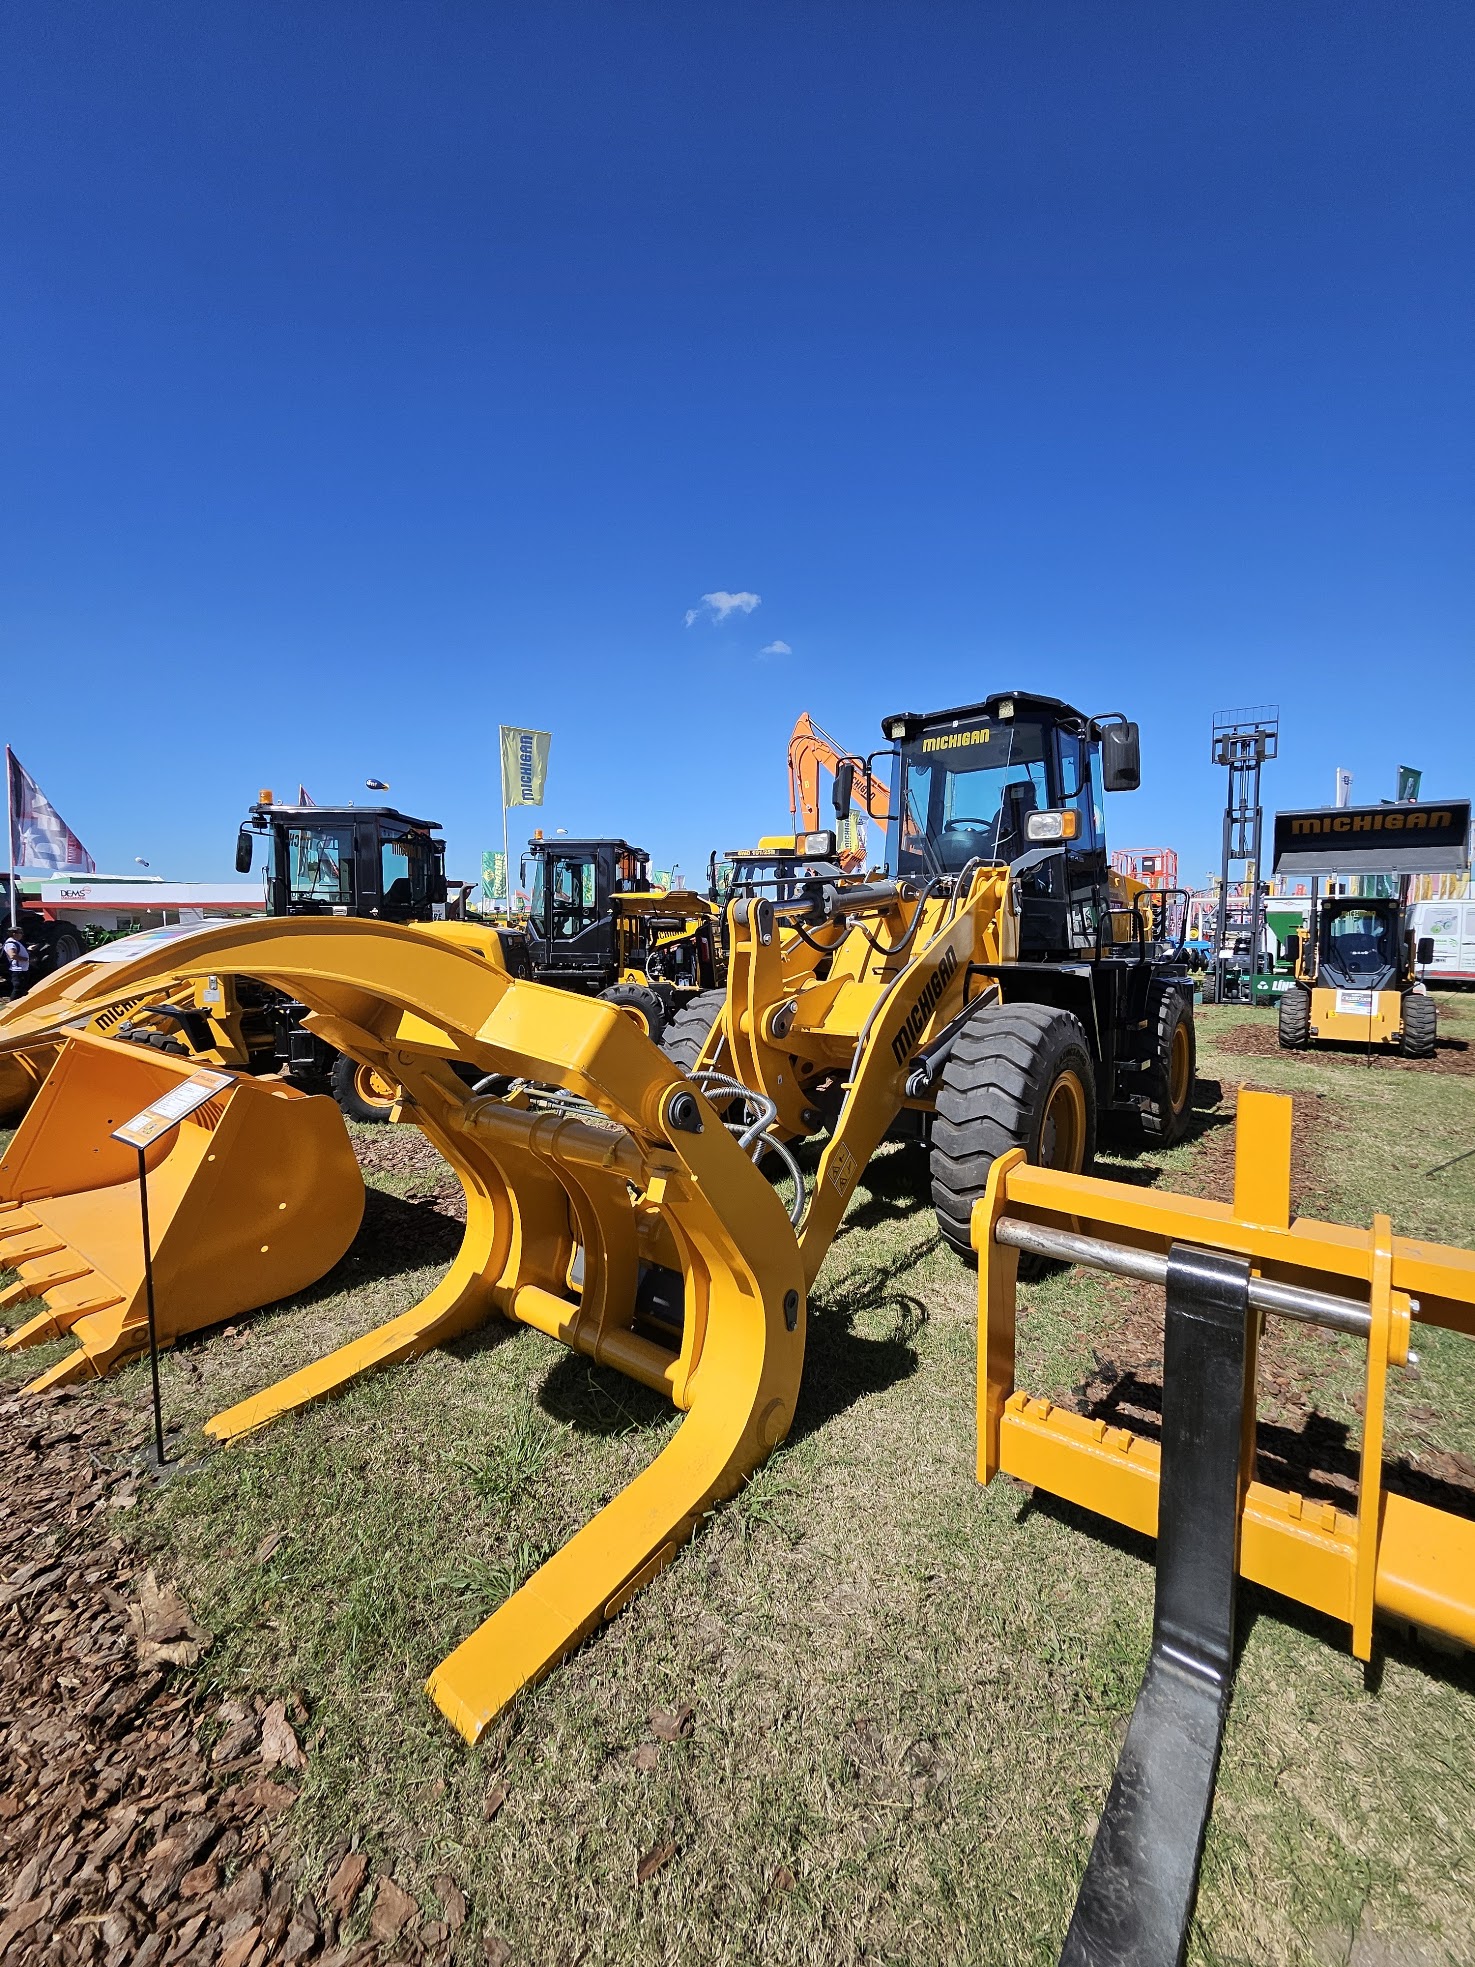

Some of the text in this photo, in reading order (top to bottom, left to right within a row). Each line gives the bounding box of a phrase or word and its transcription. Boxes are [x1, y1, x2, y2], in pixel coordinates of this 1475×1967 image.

[922, 728, 990, 753] MICHIGAN
[520, 735, 534, 801] MICHIGAN
[1291, 811, 1453, 835] MICHIGAN
[60, 889, 86, 897] DEMS
[94, 999, 140, 1031] MICHI
[891, 944, 958, 1068] MICHIGAN
